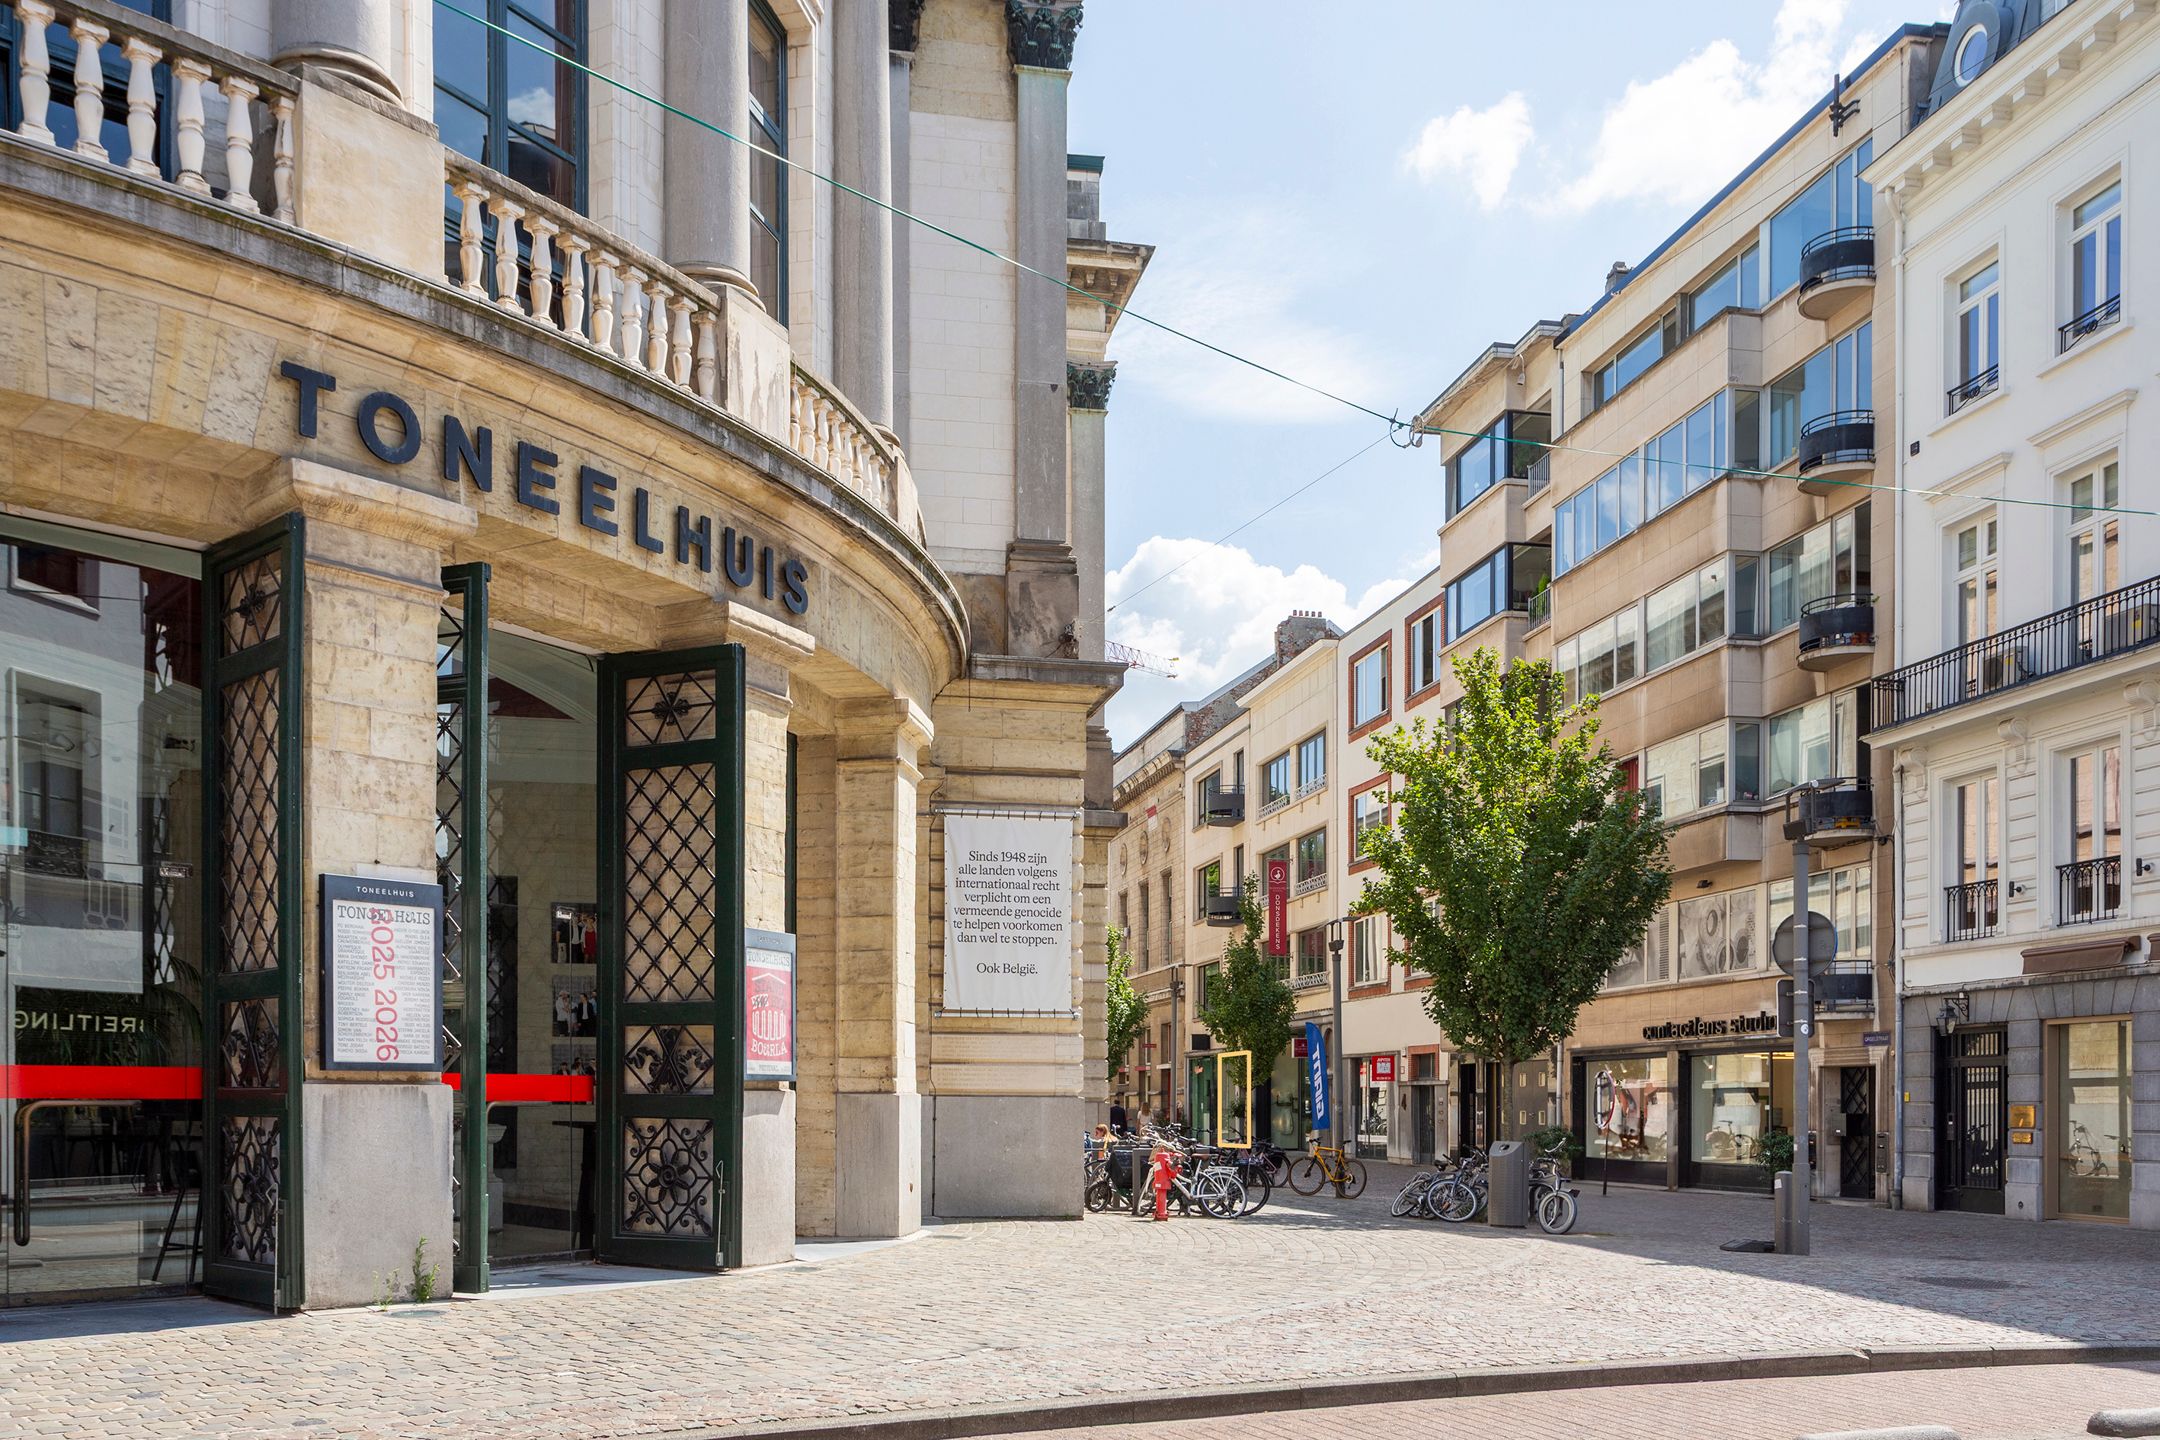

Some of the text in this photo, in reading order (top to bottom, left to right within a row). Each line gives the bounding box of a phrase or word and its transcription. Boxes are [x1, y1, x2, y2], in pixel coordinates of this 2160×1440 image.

[281, 360, 810, 615] TONEELHUIS
[968, 850, 1048, 867] Sinds 1948 zijn
[958, 863, 1058, 880] alle landen volgens
[955, 876, 1061, 891] internationaal recht
[356, 886, 415, 898] TONEELHUIS
[964, 891, 1051, 905] verplicht om een
[953, 905, 1062, 920] vermeende genocide
[952, 918, 1063, 933] te helpen voorkomen
[956, 931, 1058, 947] dan wel te stoppen.
[976, 962, 1038, 977] Ook België.
[374, 989, 400, 1062] 2026
[1730, 1010, 1777, 1034] studio
